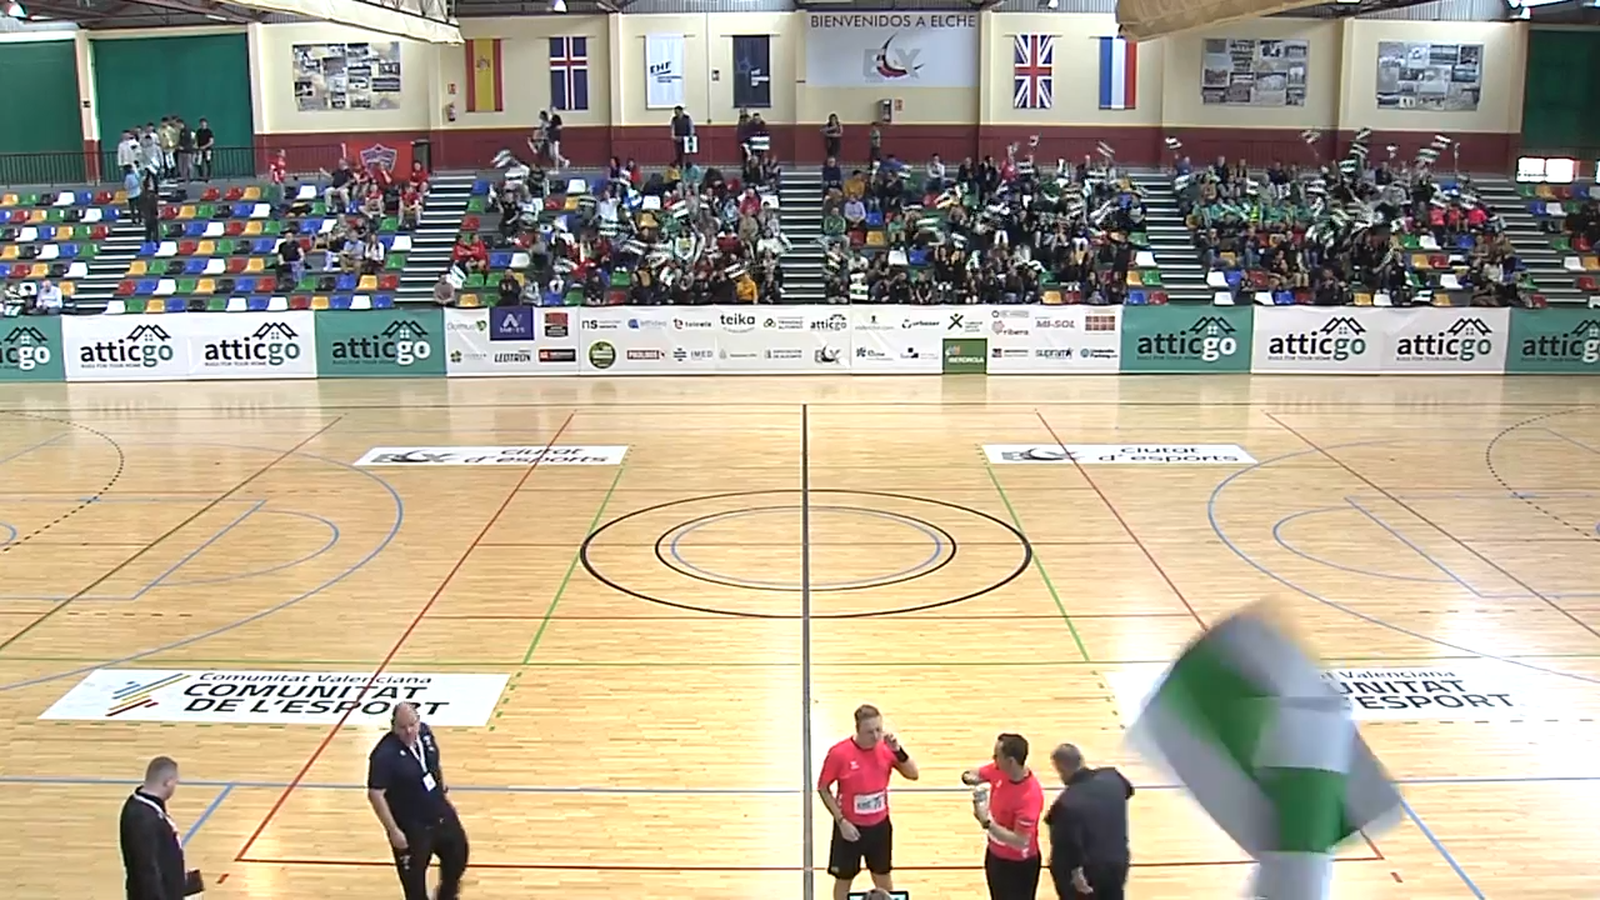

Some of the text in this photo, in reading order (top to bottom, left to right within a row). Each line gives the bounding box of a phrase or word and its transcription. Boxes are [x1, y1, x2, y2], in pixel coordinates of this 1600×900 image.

[810, 14, 976, 28] BIENVENIDOS A ELCHE
[720, 313, 756, 325] teika
[810, 319, 847, 331] atticgo
[81, 338, 173, 368] atticgo
[205, 336, 300, 366] atticgo
[332, 335, 431, 365] atticgo
[1137, 330, 1236, 361] atticgo
[1268, 331, 1366, 360] atticgo
[1397, 332, 1492, 361] atticgo
[199, 672, 432, 684] Comunitat Valenciana
[1339, 670, 1456, 679] Valenciana
[183, 683, 428, 699] COMUNITAT
[184, 698, 246, 712] DE
